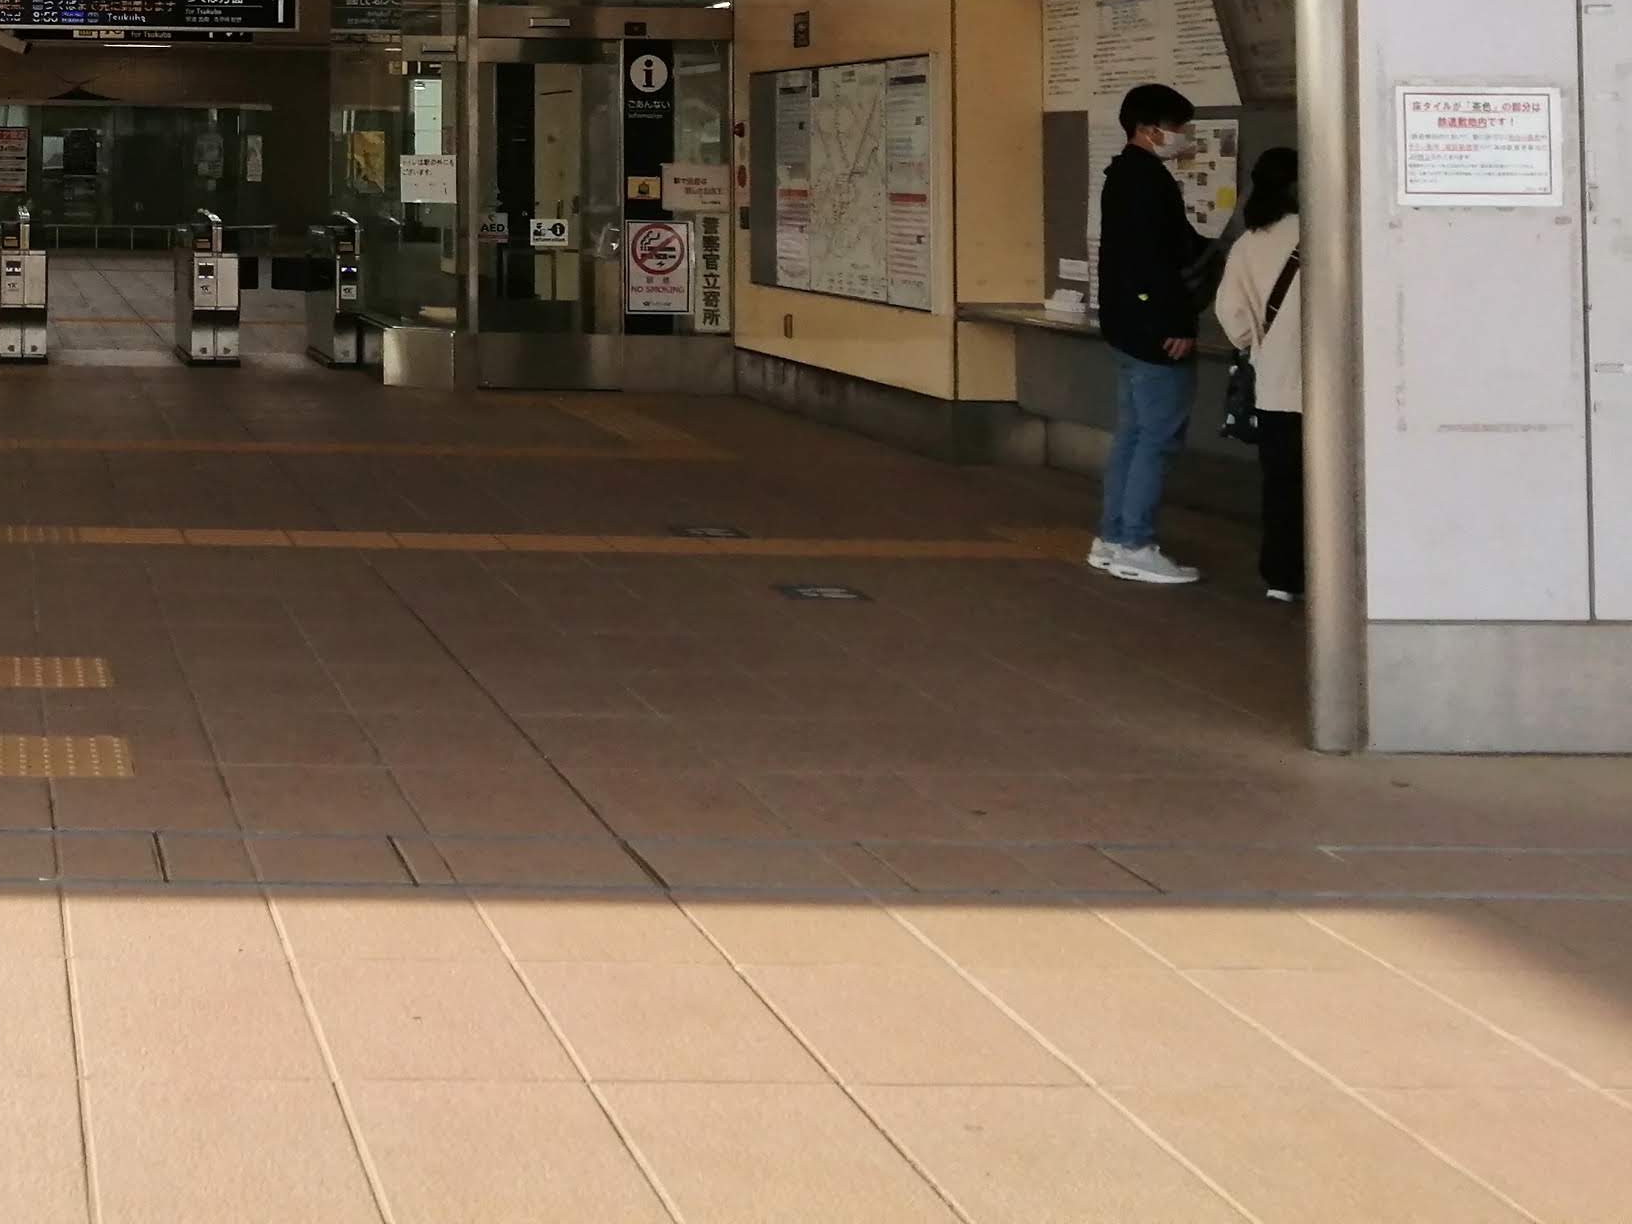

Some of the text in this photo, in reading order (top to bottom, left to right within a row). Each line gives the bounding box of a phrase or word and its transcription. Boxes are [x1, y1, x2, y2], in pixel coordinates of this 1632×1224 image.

[481, 224, 505, 232] AED
[702, 217, 721, 326] 警察官立寄所
